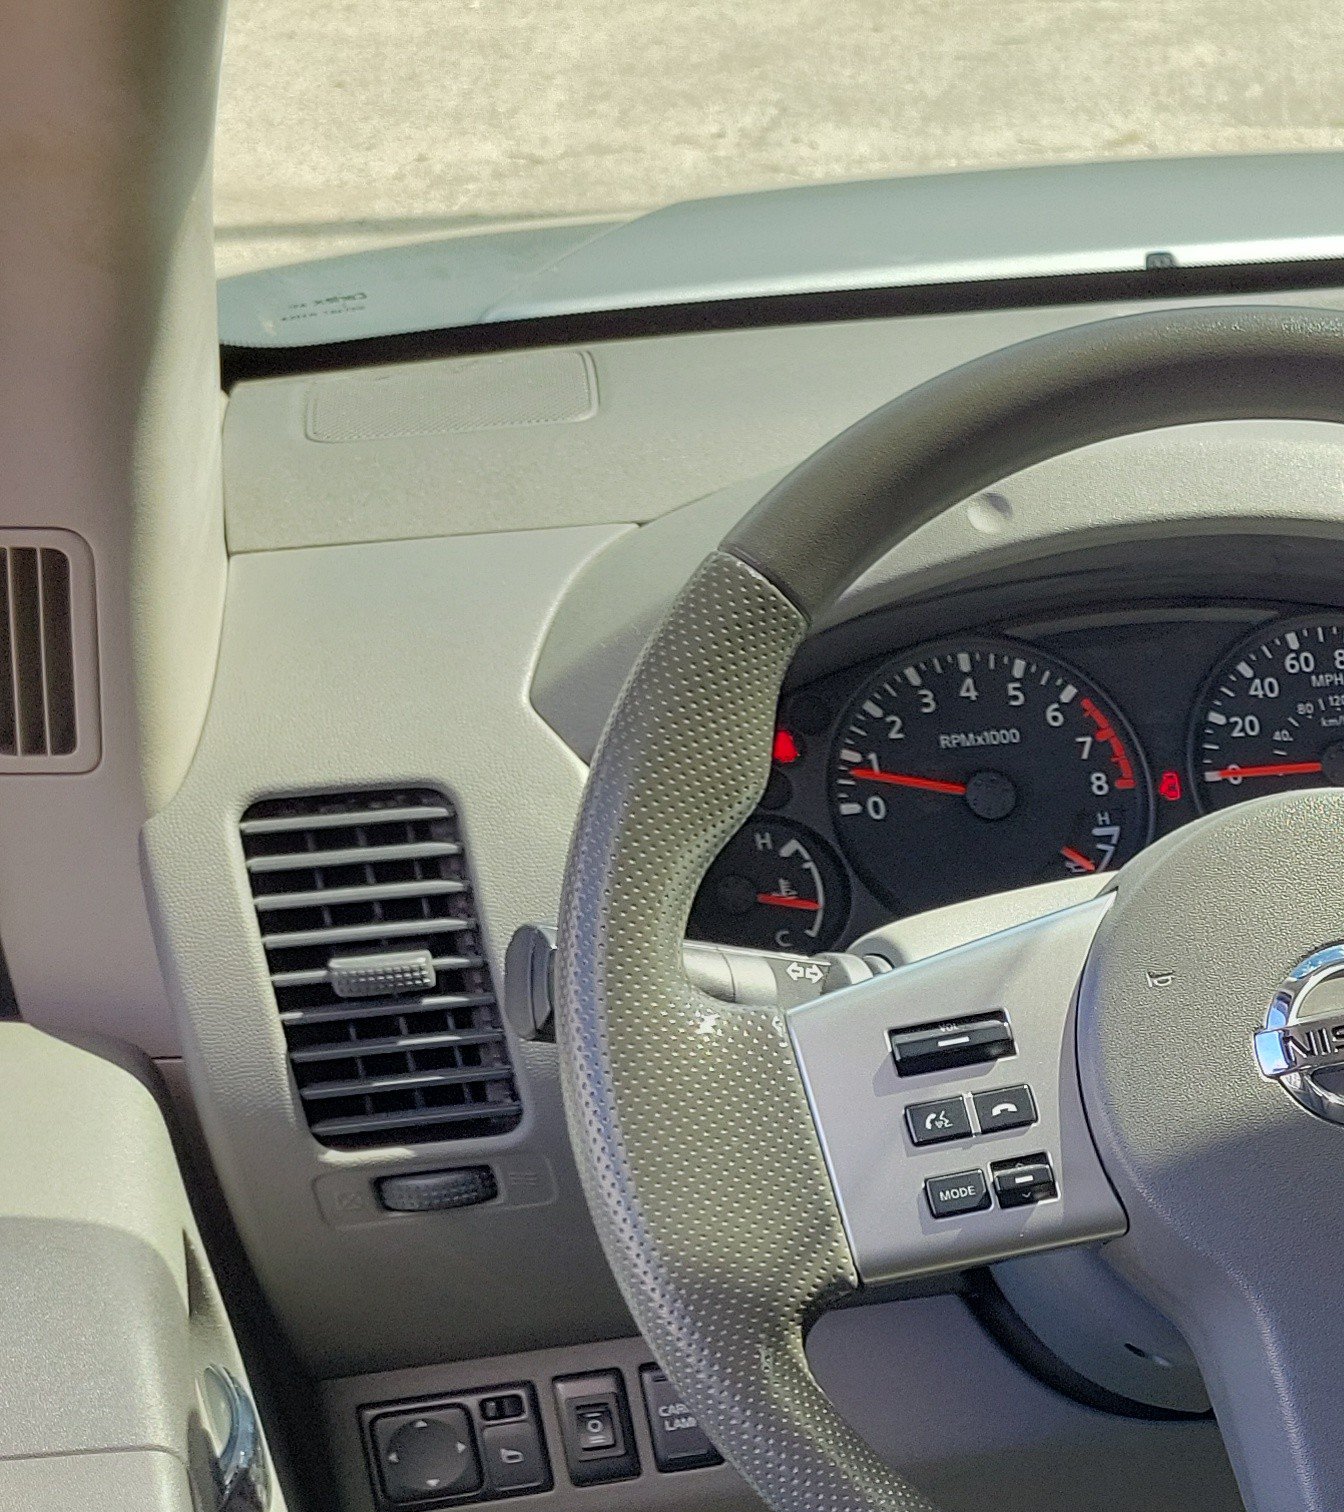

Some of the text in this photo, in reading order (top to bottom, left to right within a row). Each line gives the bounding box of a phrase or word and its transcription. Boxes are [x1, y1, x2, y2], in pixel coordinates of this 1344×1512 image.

[1284, 653, 1315, 674] 60
[960, 678, 978, 701] 4
[1250, 677, 1279, 698] 40
[1311, 674, 1344, 687] MPH
[919, 690, 936, 712] 3
[1008, 683, 1025, 705] 5
[1046, 705, 1064, 728] 6
[1297, 703, 1314, 715] 80
[887, 717, 904, 739] 2
[1229, 716, 1260, 737] 20
[938, 728, 1021, 750] RPMx1000
[1075, 738, 1094, 760] 7
[867, 753, 881, 772] 1
[1091, 773, 1109, 796] 8
[867, 797, 886, 820] 0
[1096, 811, 1110, 826] H
[754, 832, 773, 851] H
[775, 930, 791, 948] C
[939, 1184, 977, 1203] MODE
